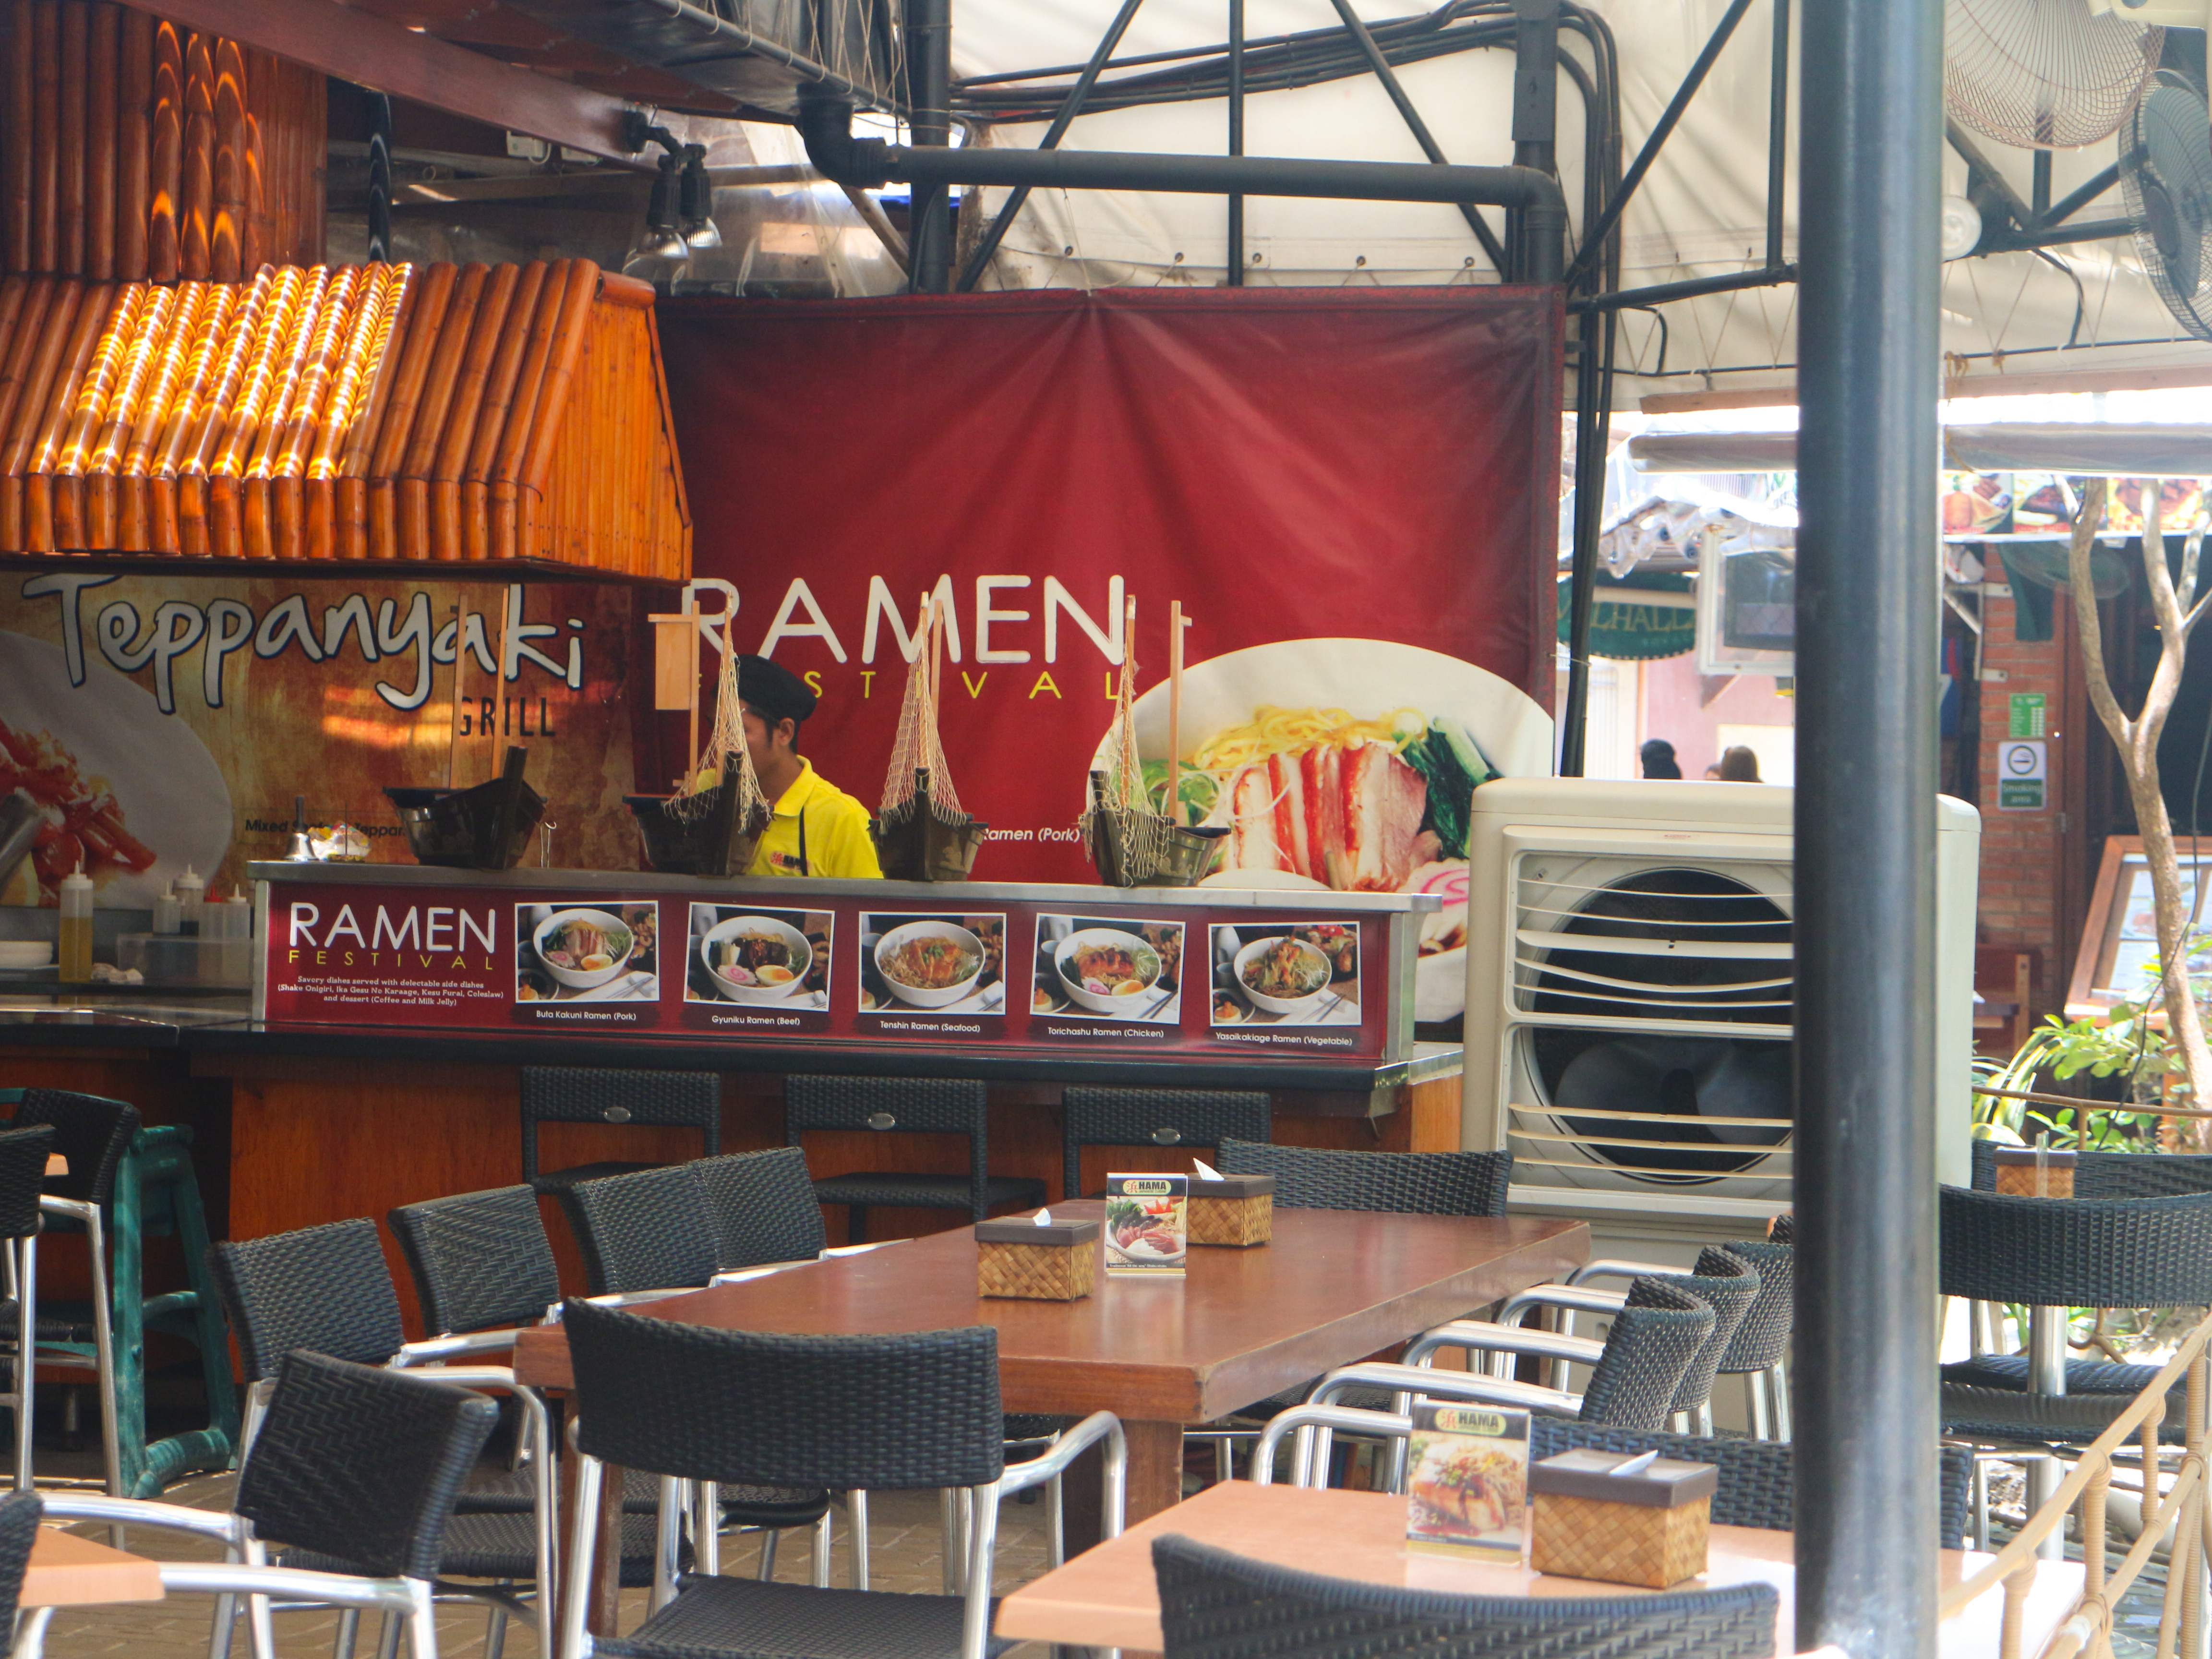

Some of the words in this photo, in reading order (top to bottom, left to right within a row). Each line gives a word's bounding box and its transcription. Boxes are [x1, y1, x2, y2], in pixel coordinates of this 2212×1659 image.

[682, 574, 1124, 665] RAMEN
[22, 573, 585, 715] Teppanyaki
[460, 697, 555, 736] GRILL
[245, 819, 288, 832] Mixed
[1038, 827, 1080, 842] (Pork)
[289, 902, 496, 953] RAMEN
[289, 950, 493, 970] FESTIVAL
[298, 976, 325, 985] Savory
[400, 979, 440, 987] delectable
[460, 981, 484, 989] dishes
[278, 984, 303, 992] (Shake
[305, 985, 334, 994] Onigiri,
[385, 988, 420, 997] Karaage,
[443, 989, 465, 998] Furai,
[467, 990, 504, 998] Coleslaw)
[371, 996, 399, 1004] (Coffee
[436, 998, 457, 1007] Jelly)
[536, 1010, 553, 1018] Buta
[555, 1011, 582, 1019] Kakuni
[613, 1012, 637, 1021] (Pork)
[711, 1015, 745, 1024] Gyuniku
[747, 1016, 775, 1024] Ramen
[777, 1017, 801, 1025] (Beef)
[880, 1021, 909, 1029] Tenshin
[911, 1022, 939, 1030] Ramen
[941, 1023, 981, 1033] (Seafood)
[1048, 1027, 1091, 1035] Torichashu
[1093, 1028, 1122, 1036] Ramen
[1124, 1029, 1164, 1038] (Chicken)
[1215, 1032, 1271, 1044] Yasaikakiage
[1273, 1034, 1301, 1043] Ramen
[1304, 1035, 1352, 1046] (Vegetable)
[1126, 1181, 1138, 1193] 浜
[1138, 1181, 1166, 1190] HAMA
[1459, 1411, 1499, 1427] HAMA
